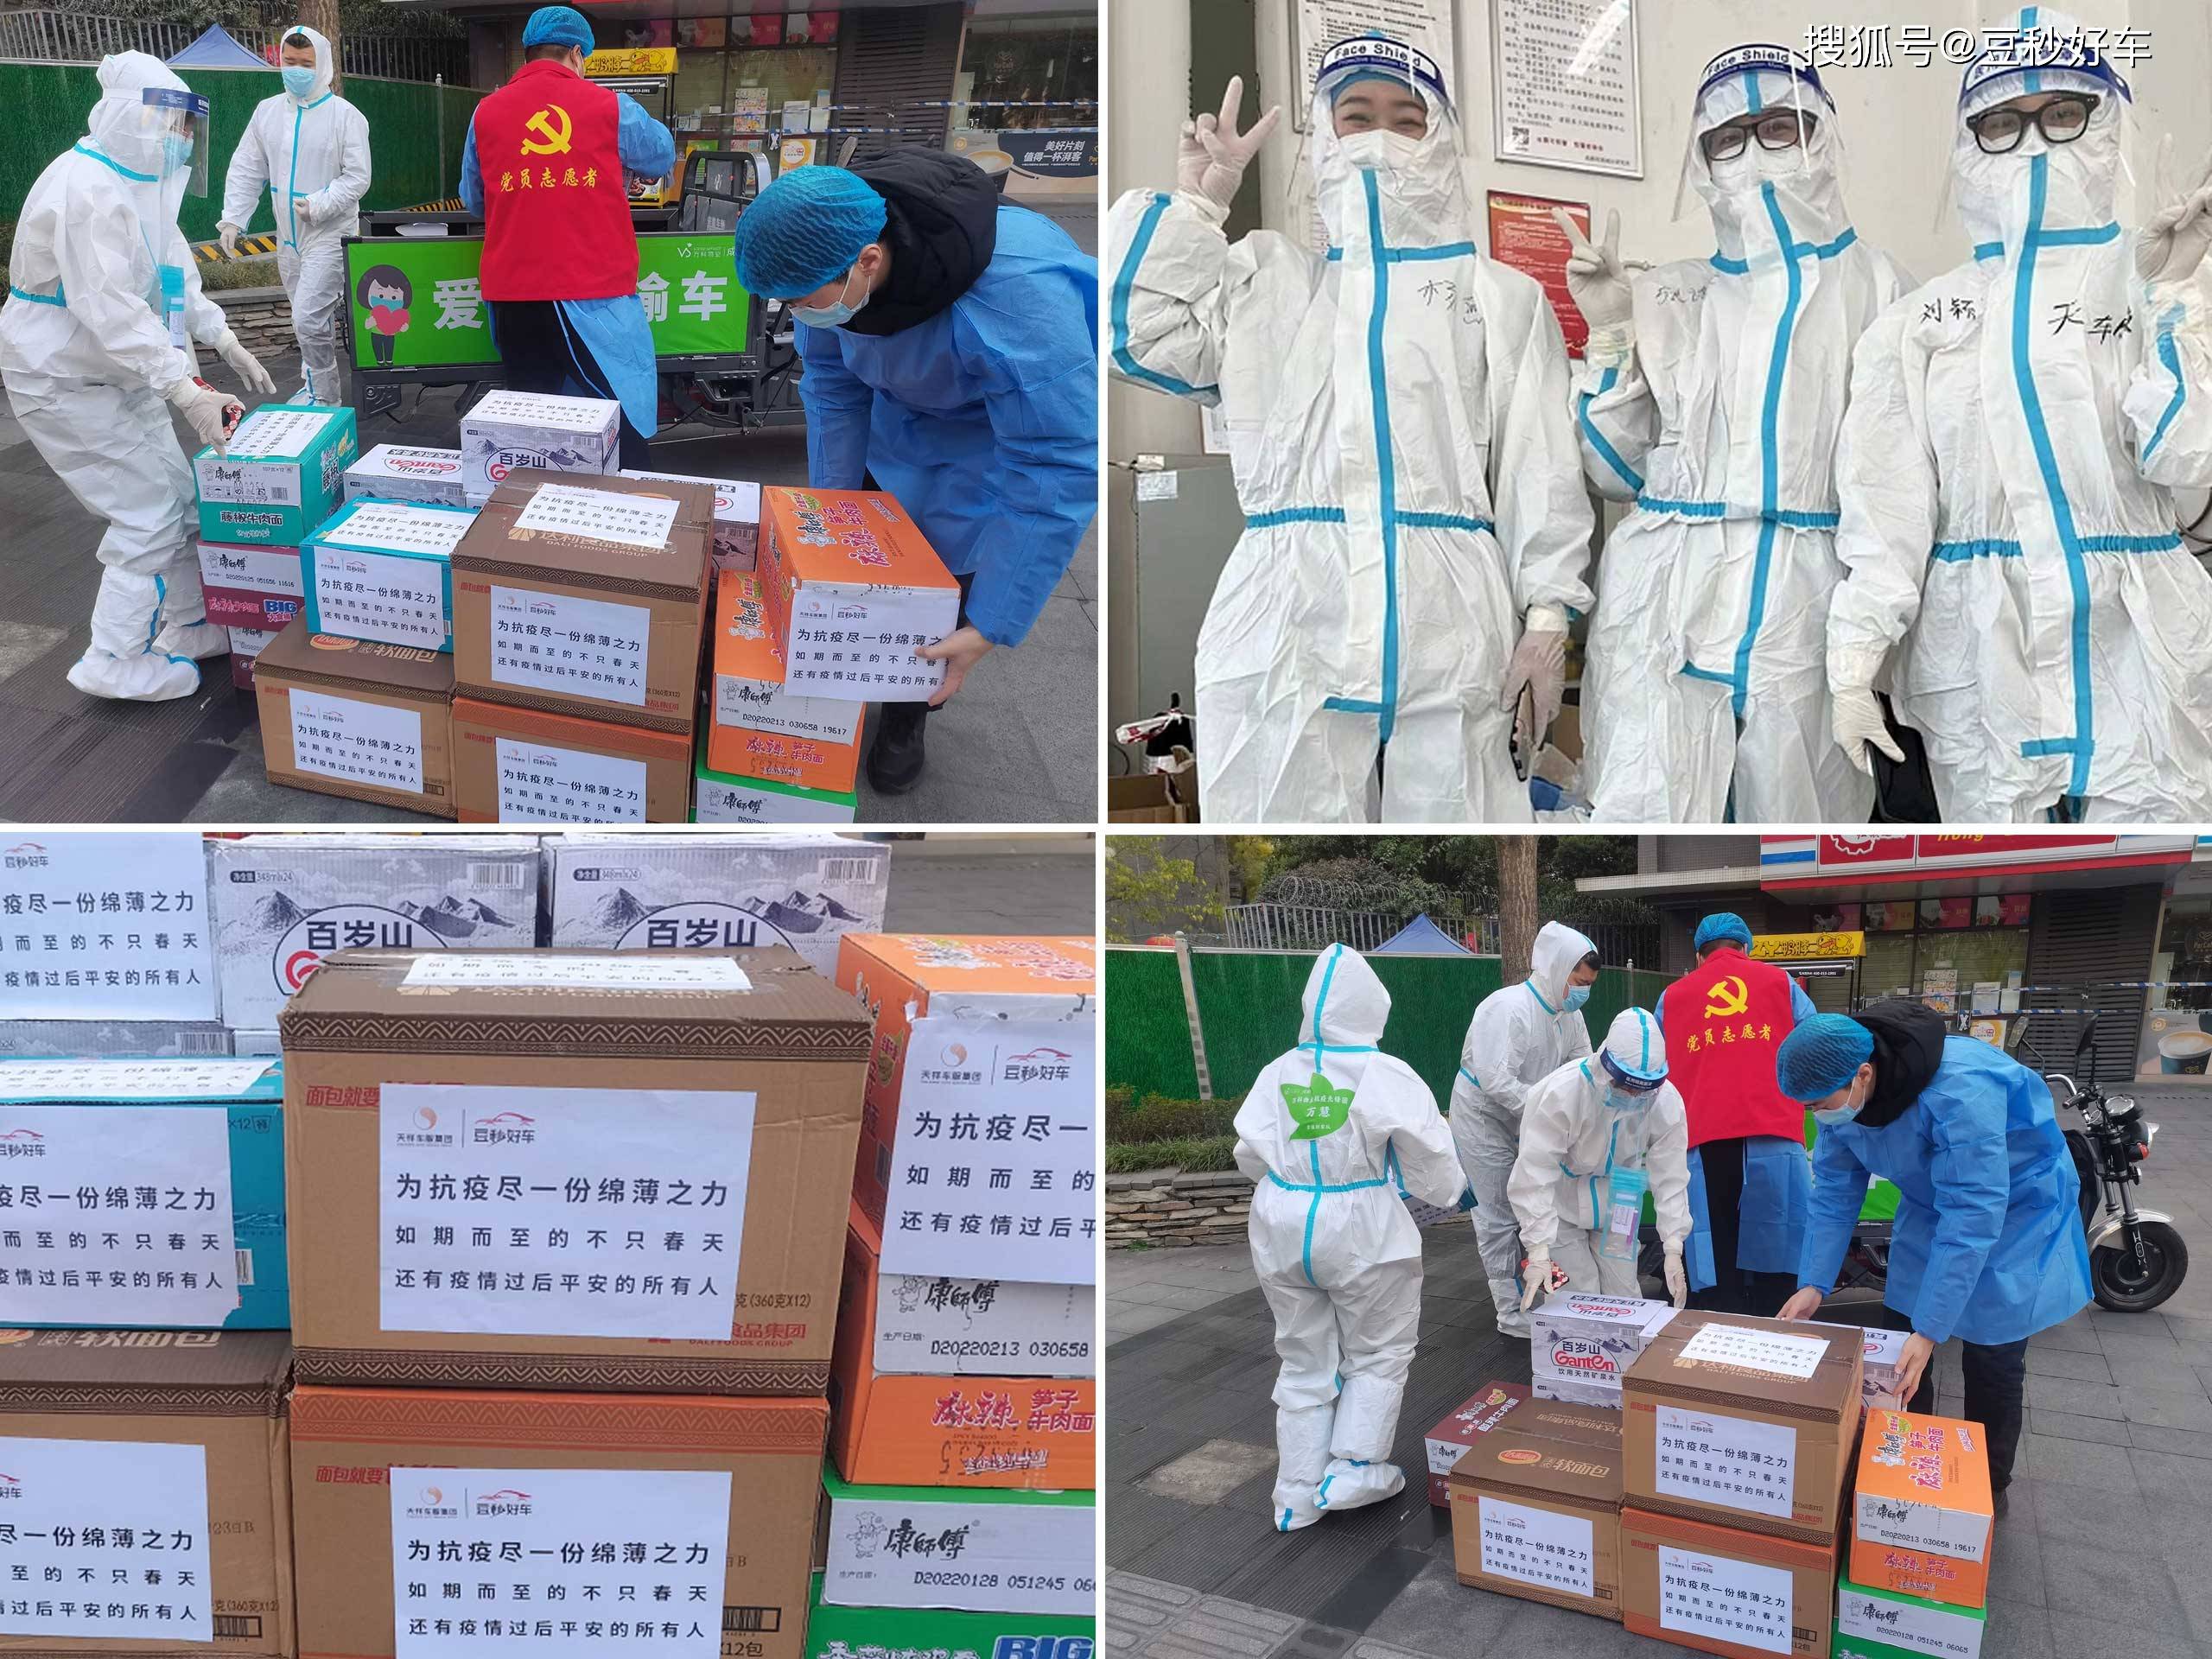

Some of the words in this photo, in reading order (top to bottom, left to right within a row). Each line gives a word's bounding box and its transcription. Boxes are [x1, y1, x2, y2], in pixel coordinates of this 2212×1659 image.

[1333, 44, 1367, 60] Face
[1374, 42, 1421, 67] Shied
[1742, 49, 1789, 63] Shield
[1023, 151, 1082, 162] 值得一杯湃客
[1044, 140, 1085, 151] 美好片刻
[500, 167, 597, 193] 党员志愿者
[433, 277, 485, 330] 爱
[499, 452, 547, 468] 百岁山
[220, 510, 283, 526] 藤椒牛肉面
[321, 578, 436, 605] 为抗疫尽一份绵薄之力
[264, 599, 297, 614] BIG
[321, 596, 437, 621] 如期而至的不只春天
[324, 611, 439, 636] 还有疫情过后平安的所有人
[498, 620, 640, 652] 为抗疫尽一份绵薄之力
[497, 639, 639, 671] 如期而至的不只春天
[497, 656, 639, 688] 还有疫情过后平安的所有人
[792, 670, 945, 686] 还有疫情过后平安的所有
[742, 713, 785, 727] D20220213
[789, 720, 818, 731] 030658
[298, 724, 416, 755] 为抗疫尽一份绵薄之力
[746, 736, 788, 758] 麻辣
[792, 741, 816, 752] 笋子
[298, 741, 416, 770] 如期而至的不只春天
[791, 751, 824, 765] 牛肉面
[300, 755, 417, 785] 还有疫情过后平安的所有人
[504, 768, 639, 801] 为抗疫尽一份绵薄之力
[504, 786, 639, 817] 如期而至的不只春天
[3, 890, 194, 914] 疫尽一份绵薄之力
[0, 933, 199, 952] 而至的不只春天
[306, 920, 413, 950] 百岁山
[646, 918, 757, 949] 百岁山
[4, 969, 201, 988] 疫情过后平安的所有人
[1687, 1023, 1771, 1053] 党员志愿者
[913, 1110, 1089, 1142] 为抗疫尽一
[396, 1173, 728, 1208] 为抗疫尽一份绵薄之力
[906, 1164, 1095, 1192] 如期而至的
[899, 1211, 1096, 1239] 还有疫情过后平
[3, 1231, 220, 1251] 而至的不只春天
[395, 1224, 724, 1253] 如期而至的不只春天
[395, 1268, 719, 1296] 还有疫情过后平安的所有人
[930, 1341, 1020, 1357] D20220213
[1028, 1342, 1089, 1357] 030658
[1562, 1340, 1600, 1355] 百岁山
[1558, 1368, 1616, 1382] 饮用天然矿泉水
[931, 1390, 1022, 1427] 麻辣
[1031, 1389, 1080, 1409] 笋子
[1026, 1408, 1096, 1433] 牛肉面
[1662, 1436, 1788, 1468] 为抗疫尽一份绵薄之力
[1909, 1431, 1927, 1450] 笋子
[1927, 1427, 1944, 1452] 牛肉面
[315, 1465, 391, 1485] 面包就要
[1554, 1459, 1611, 1478] 软面包
[1661, 1454, 1788, 1485] 如期而至的不只春天
[1909, 1454, 1943, 1491] 麻辣
[1661, 1471, 1786, 1502] 还有疫情过后平安的所有人
[0, 1524, 193, 1551] 尽一份绵薄之力
[1484, 1529, 1588, 1561] 为抗疫尽一份绵薄之力
[1880, 1529, 1920, 1543] D20220213
[1923, 1537, 1950, 1548] 030658
[1954, 1543, 1977, 1554] 19617
[408, 1540, 709, 1565] 为抗疫尽一份绵薄之力
[1485, 1545, 1588, 1575] 如期而至的不只春天
[1884, 1552, 1922, 1573] 麻辣
[11, 1565, 195, 1587] 至的不只春天
[913, 1571, 999, 1587] D20220128
[1007, 1575, 1065, 1591] 051245
[1485, 1558, 1588, 1588] 还有疫情过后平安的所有人
[1925, 1567, 1957, 1580] 牛肉面
[408, 1581, 707, 1602] 如期而至的不只春天
[1664, 1574, 1786, 1608] 为抗疫尽一份绵薄之力
[0, 1599, 197, 1622] 过后平安的所有人
[1664, 1591, 1786, 1624] 如期而至的不只春天
[409, 1618, 705, 1639] 还有疫情过后平安的所有人
[1665, 1605, 1786, 1639] 还有疫情过后平安的所有人
[1876, 1626, 1914, 1641] D20220128
[1916, 1635, 1943, 1648] 051245
[1946, 1643, 1968, 1654] 06065
